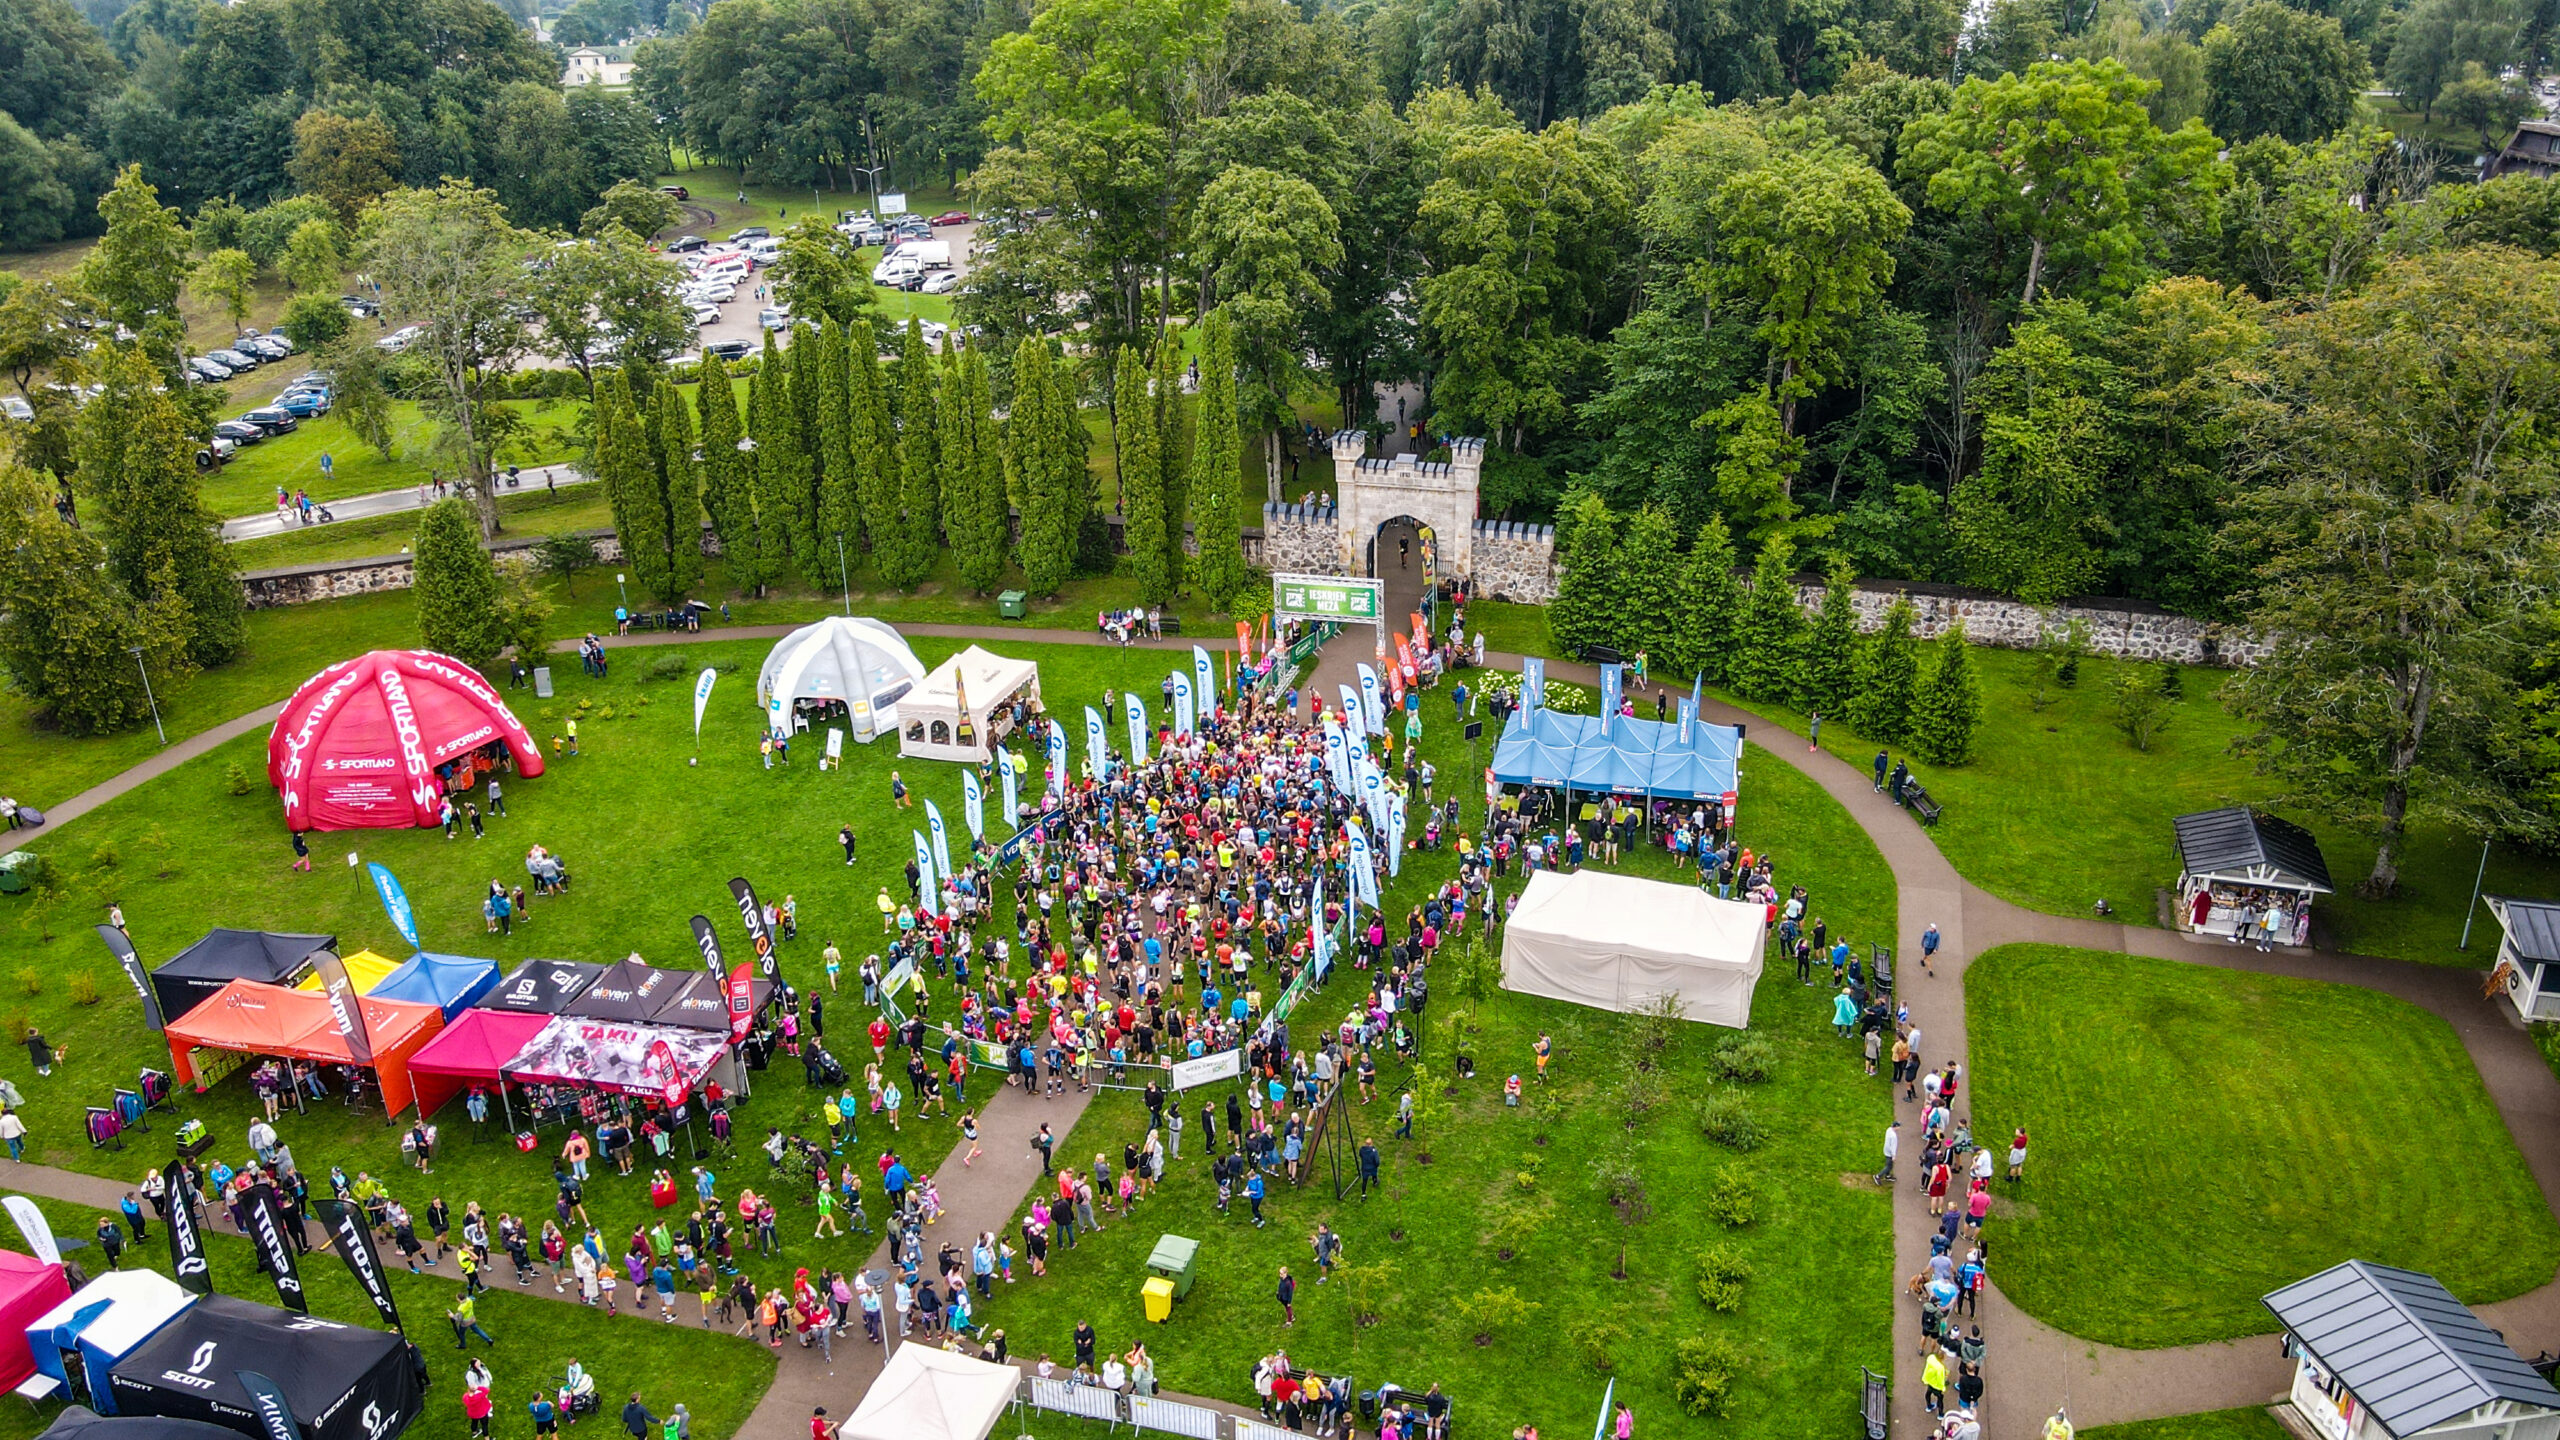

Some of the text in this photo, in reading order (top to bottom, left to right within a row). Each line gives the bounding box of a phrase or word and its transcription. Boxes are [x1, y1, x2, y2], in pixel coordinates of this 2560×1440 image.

[1309, 589, 1346, 602] IESKRIEN
[414, 658, 521, 731] SPORTLAND
[286, 671, 357, 780] SPORTLAND
[381, 669, 429, 776] SPORTLAND
[445, 725, 493, 754] SPORTLAND
[339, 758, 395, 770] SPORTLAND
[739, 893, 775, 976] eleven
[637, 970, 664, 997] eleven
[591, 987, 630, 1001] eleven
[681, 997, 719, 1011] eleven
[580, 1025, 638, 1042] TAKU
[691, 1063, 709, 1085] TAKU
[622, 1085, 653, 1095] TAKU
[120, 1379, 153, 1391] SCOTT
[161, 1370, 216, 1389] SCOTT
[218, 1405, 254, 1418] SCOTT
[323, 1385, 357, 1421] SCOTT
